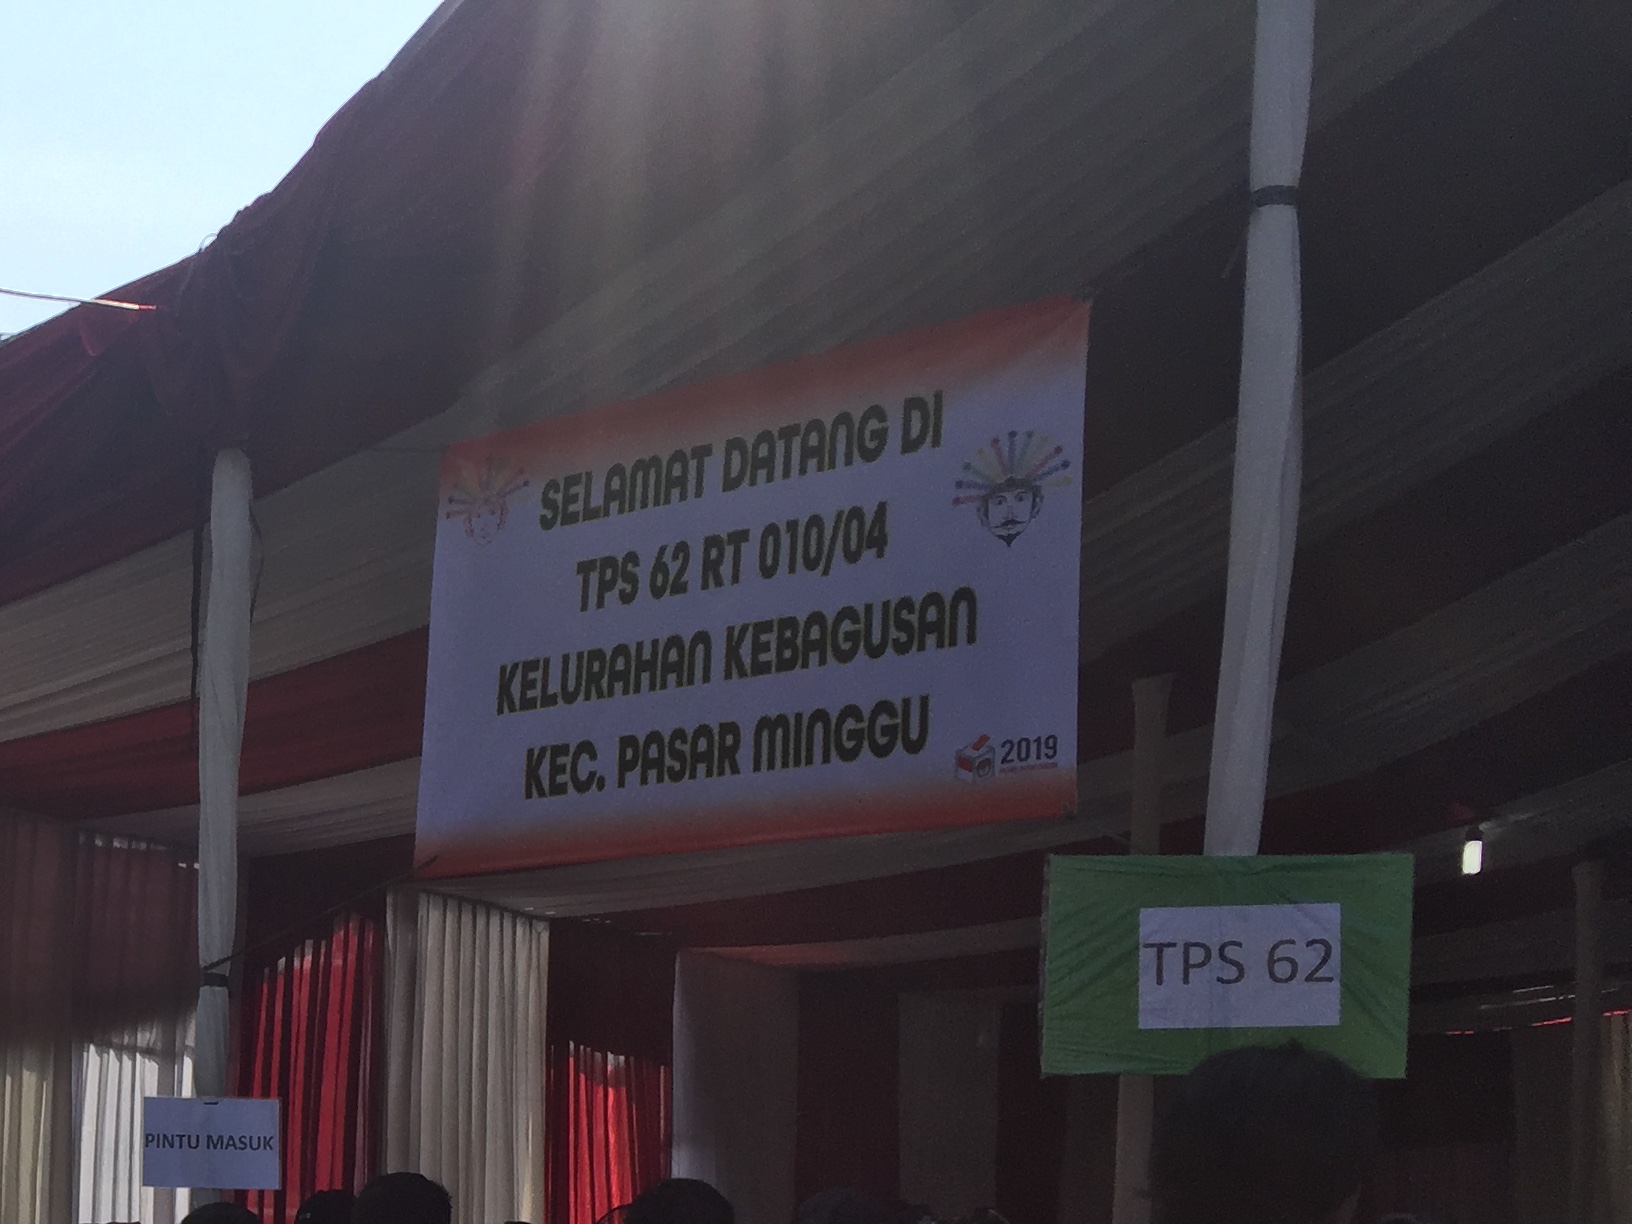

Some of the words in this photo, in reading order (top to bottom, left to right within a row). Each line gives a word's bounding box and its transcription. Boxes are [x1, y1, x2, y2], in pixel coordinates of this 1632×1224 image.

[539, 444, 713, 530] SELAMAT
[721, 404, 889, 492] DATANG
[900, 390, 944, 456] DI
[576, 552, 641, 612] TPS
[649, 541, 691, 600] 62
[700, 528, 750, 591] RT
[759, 501, 889, 577] 010/04
[495, 630, 712, 717] KELURAHAN
[723, 587, 978, 682] KEBAGUSAN
[524, 740, 606, 799] KEC.
[617, 722, 741, 790] PASAR
[753, 695, 931, 774] MINGGU
[1000, 734, 1058, 765] 2019
[1143, 939, 1246, 986] TPS
[1267, 937, 1335, 984] 62
[145, 1133, 200, 1150] PINTU
[206, 1134, 274, 1151] MASUK
